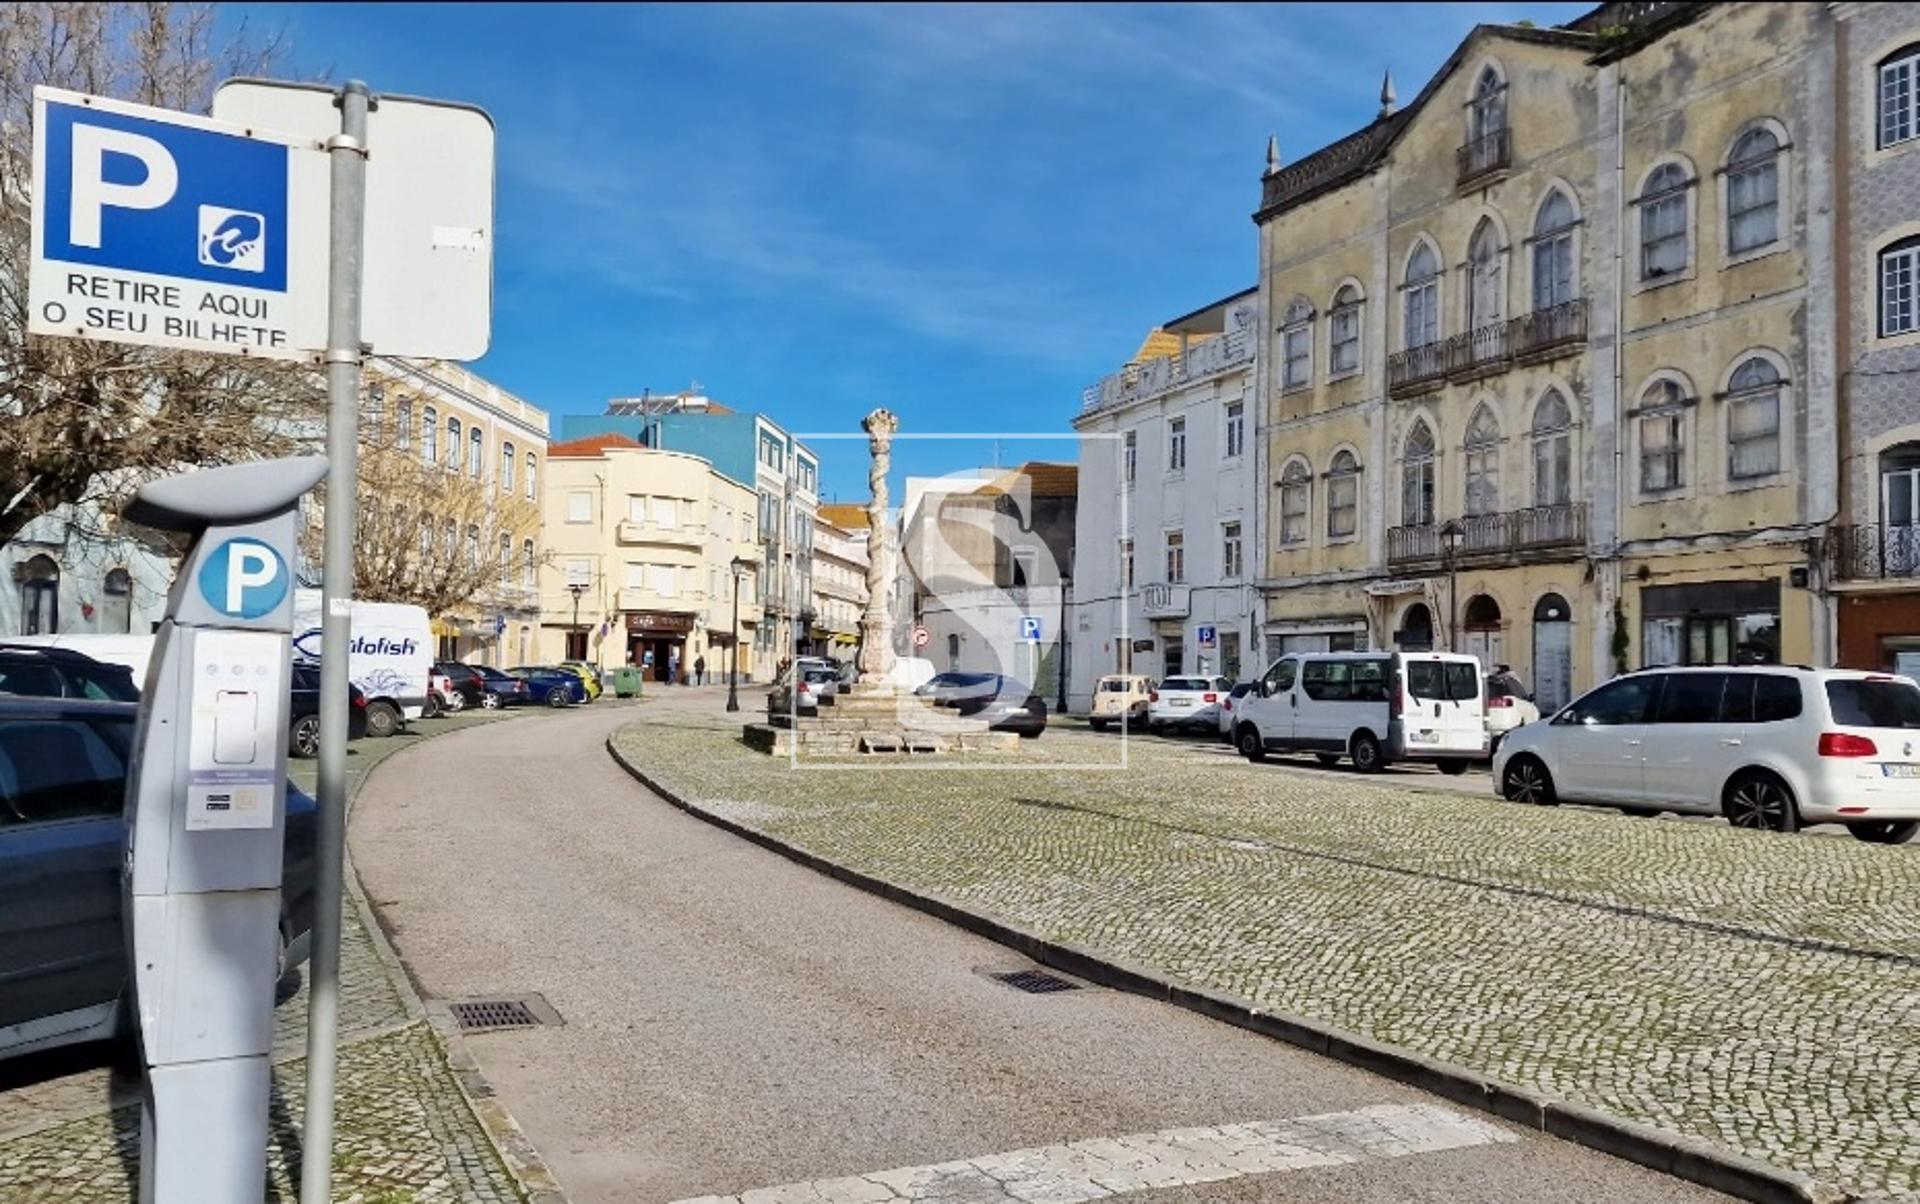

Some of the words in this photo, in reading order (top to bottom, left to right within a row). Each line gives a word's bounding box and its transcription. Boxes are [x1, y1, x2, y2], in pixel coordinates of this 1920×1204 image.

[69, 122, 178, 248] P
[67, 273, 181, 308] RETIRE
[199, 292, 268, 319] AQUI
[43, 302, 67, 323] O
[86, 307, 147, 333] SEU
[164, 316, 287, 348] BILHETE
[226, 543, 278, 612] P
[350, 636, 415, 655] itofish
[1024, 619, 1037, 637] P
